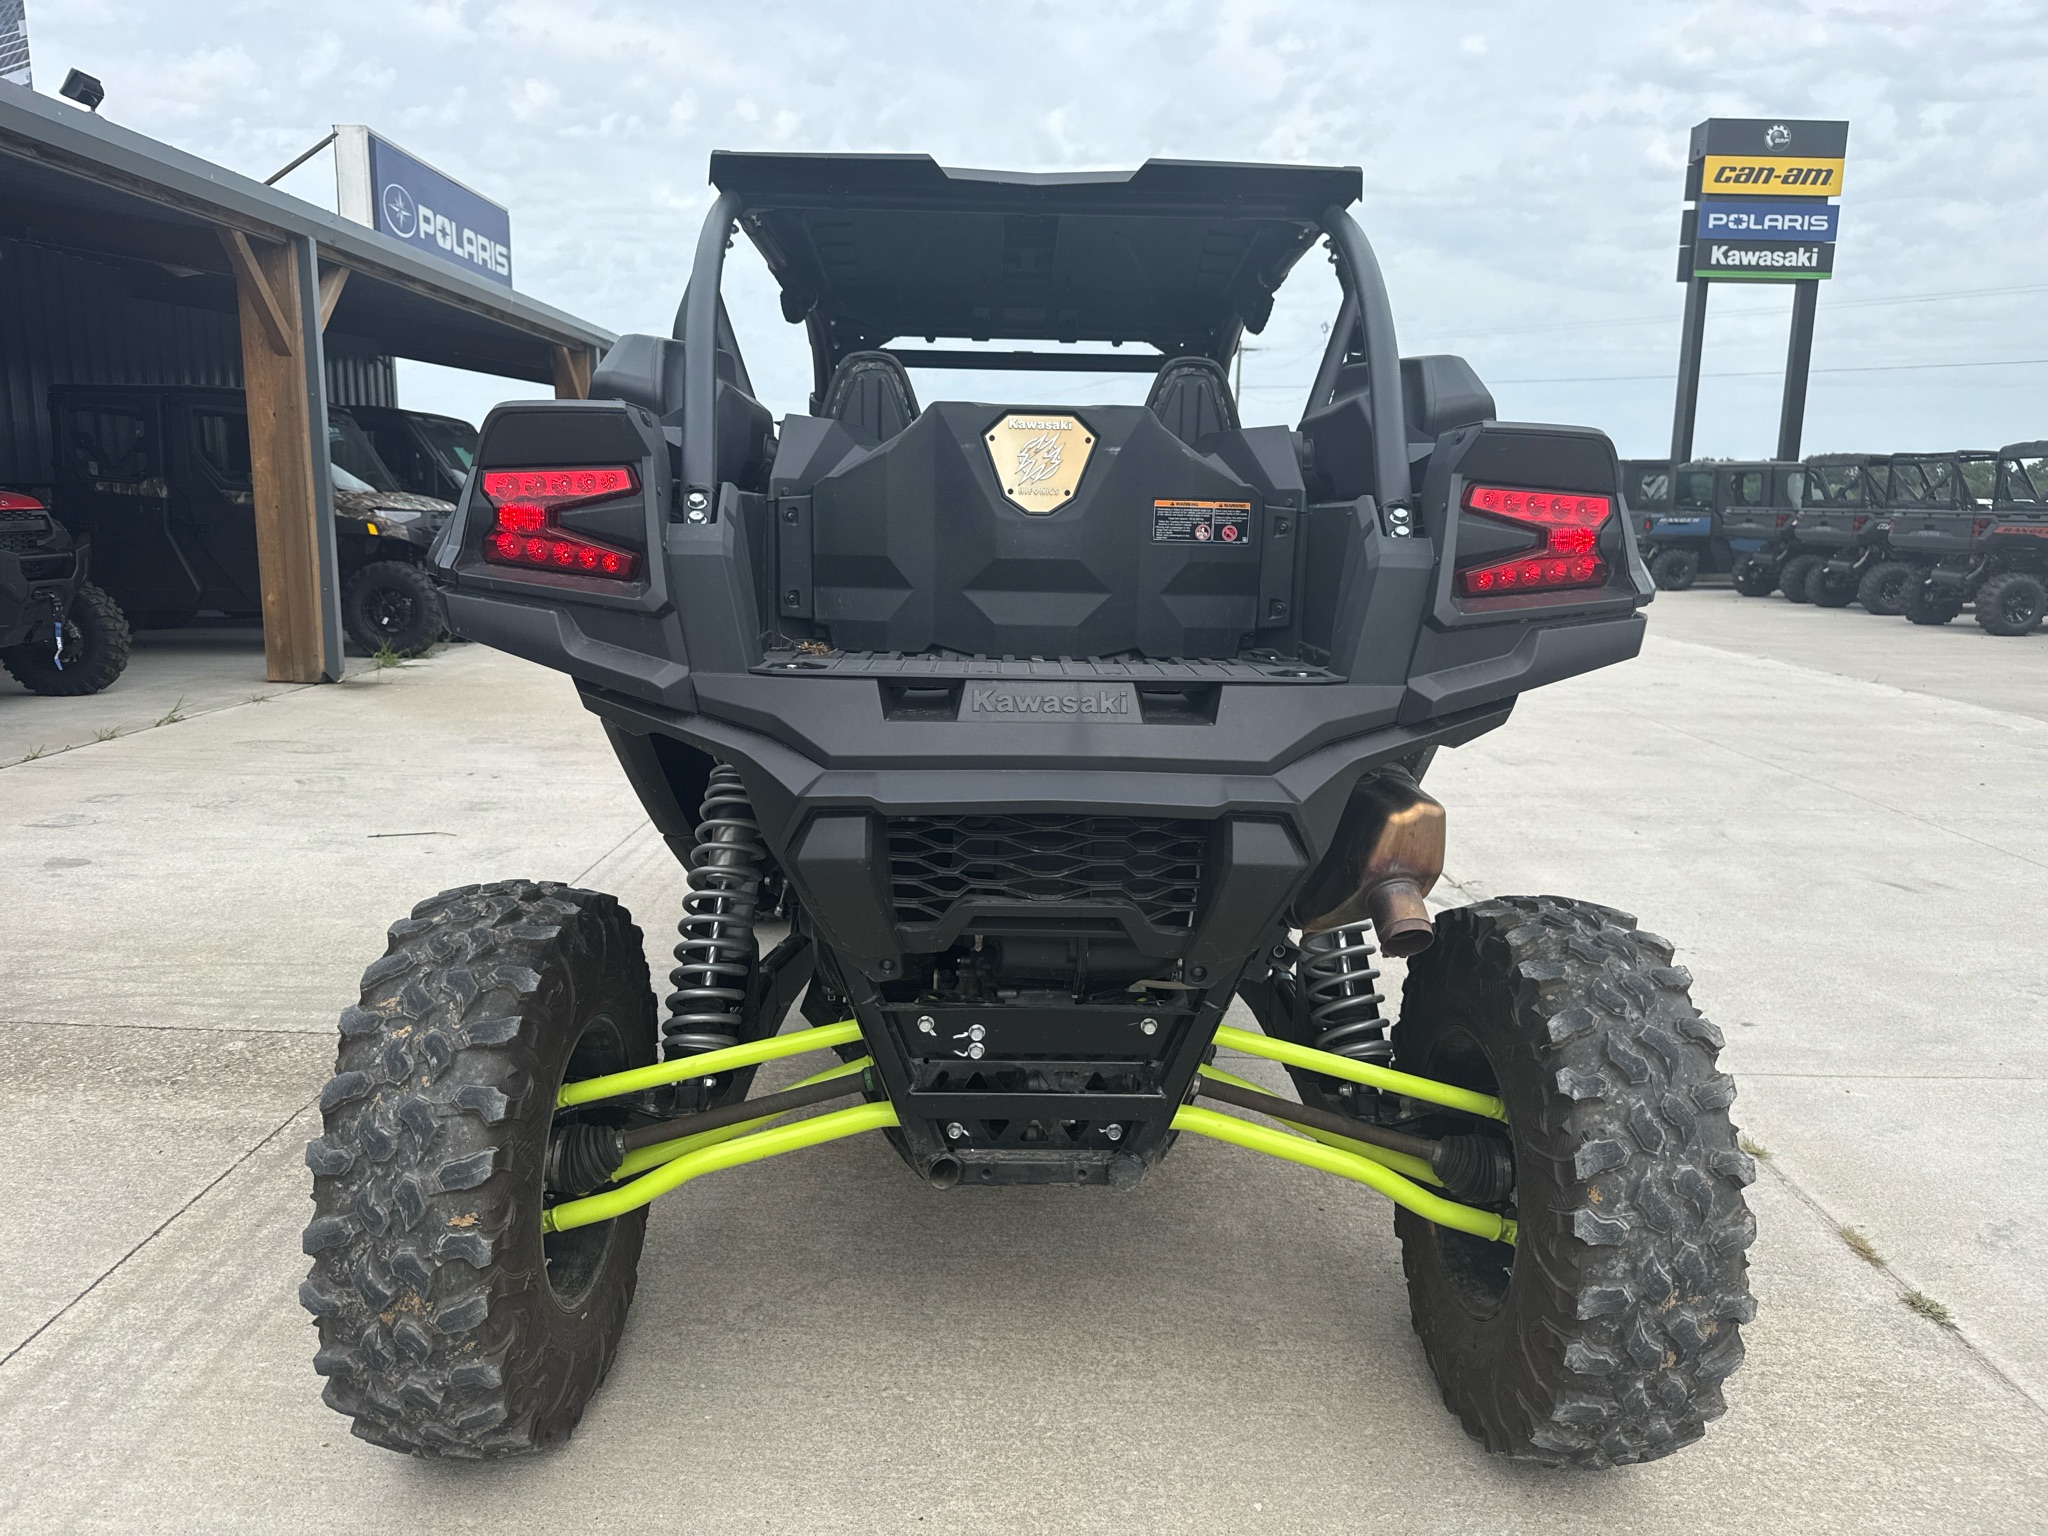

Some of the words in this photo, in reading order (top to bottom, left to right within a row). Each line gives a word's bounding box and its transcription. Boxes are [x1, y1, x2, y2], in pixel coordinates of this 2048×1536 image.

[1713, 165, 1834, 186] can-am
[1707, 213, 1829, 231] POLARIS
[418, 203, 509, 276] POLARIS
[1710, 245, 1819, 268] Kawasaki
[1008, 418, 1073, 431] Kawasaki
[1018, 487, 1060, 496] HIFONICS
[971, 688, 1129, 715] Kawasaki
